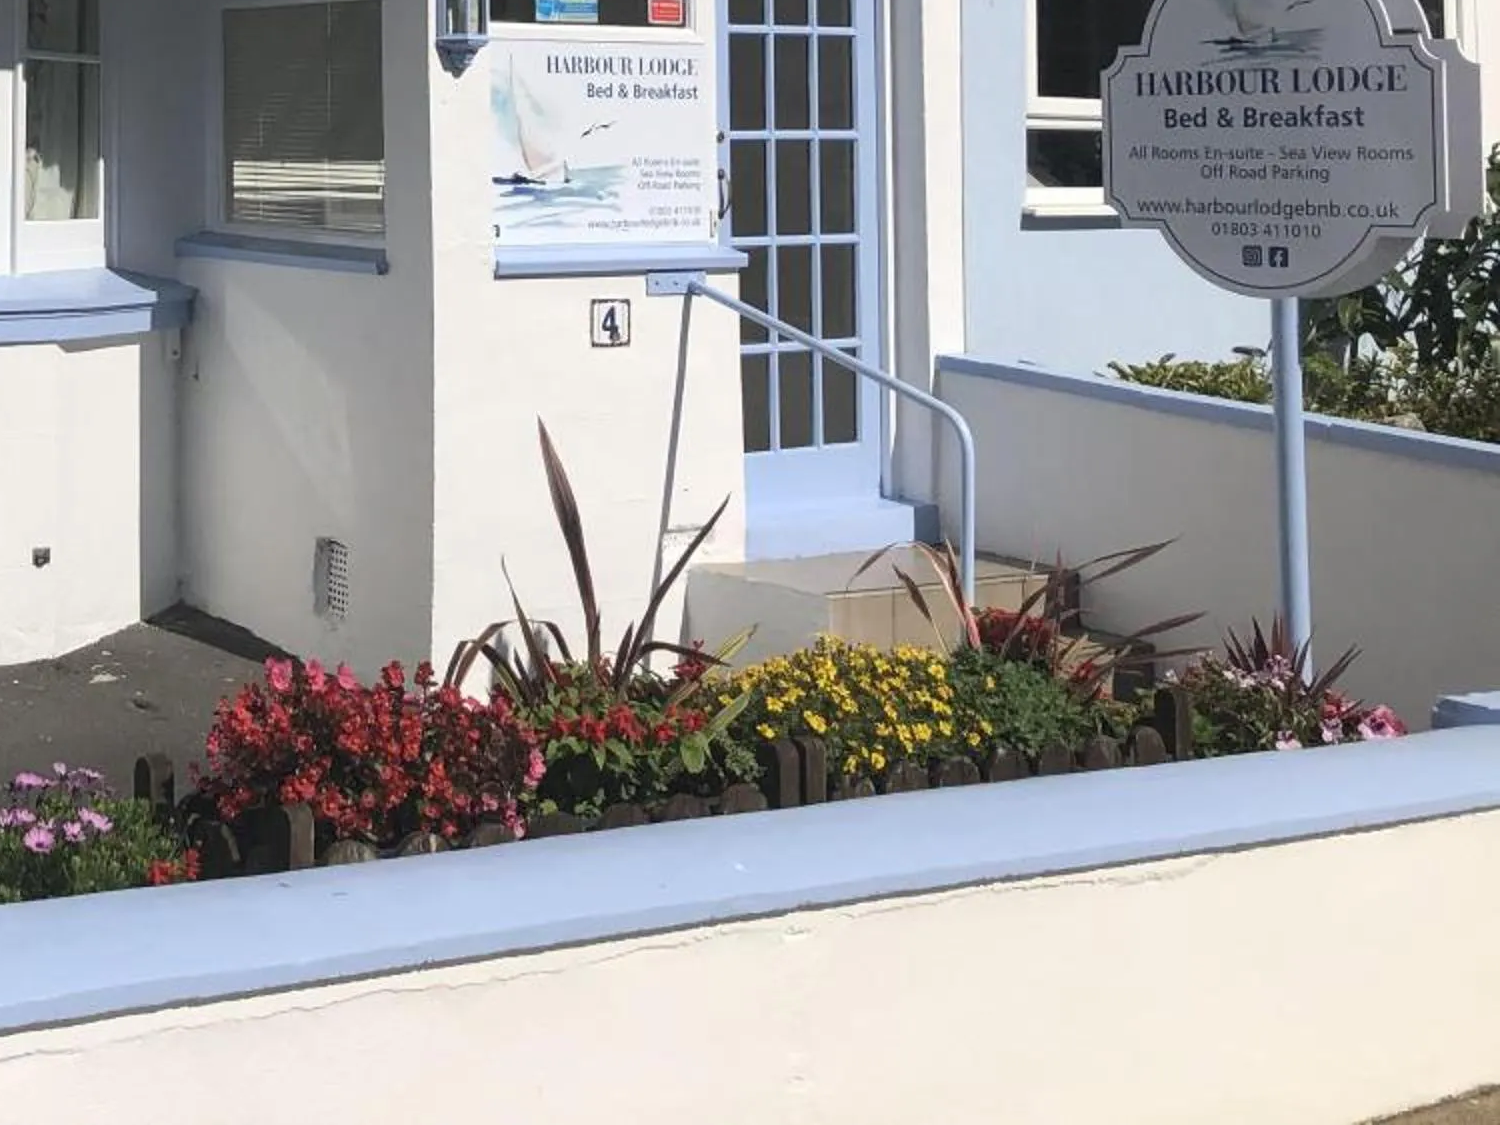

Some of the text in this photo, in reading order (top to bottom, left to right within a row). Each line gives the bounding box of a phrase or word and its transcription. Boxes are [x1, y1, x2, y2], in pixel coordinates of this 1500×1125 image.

[547, 55, 699, 76] HARBOUR LODGE
[1136, 64, 1408, 97] HARBOUR LODGE
[587, 83, 699, 100] Bed & Breakfast
[1164, 105, 1364, 128] Bed & Breakfast
[1129, 146, 1147, 160] All
[1151, 146, 1199, 160] Rooms
[1204, 146, 1264, 160] En-suite
[1279, 146, 1307, 160] Sea
[1311, 146, 1351, 160] View
[1358, 146, 1414, 161] Rooms
[1201, 164, 1330, 183] Off Road Parking
[1137, 197, 1399, 218] www.harbourlodgebnb.co.uk
[1211, 223, 1321, 238] 01803 411010
[602, 305, 620, 341] 4
